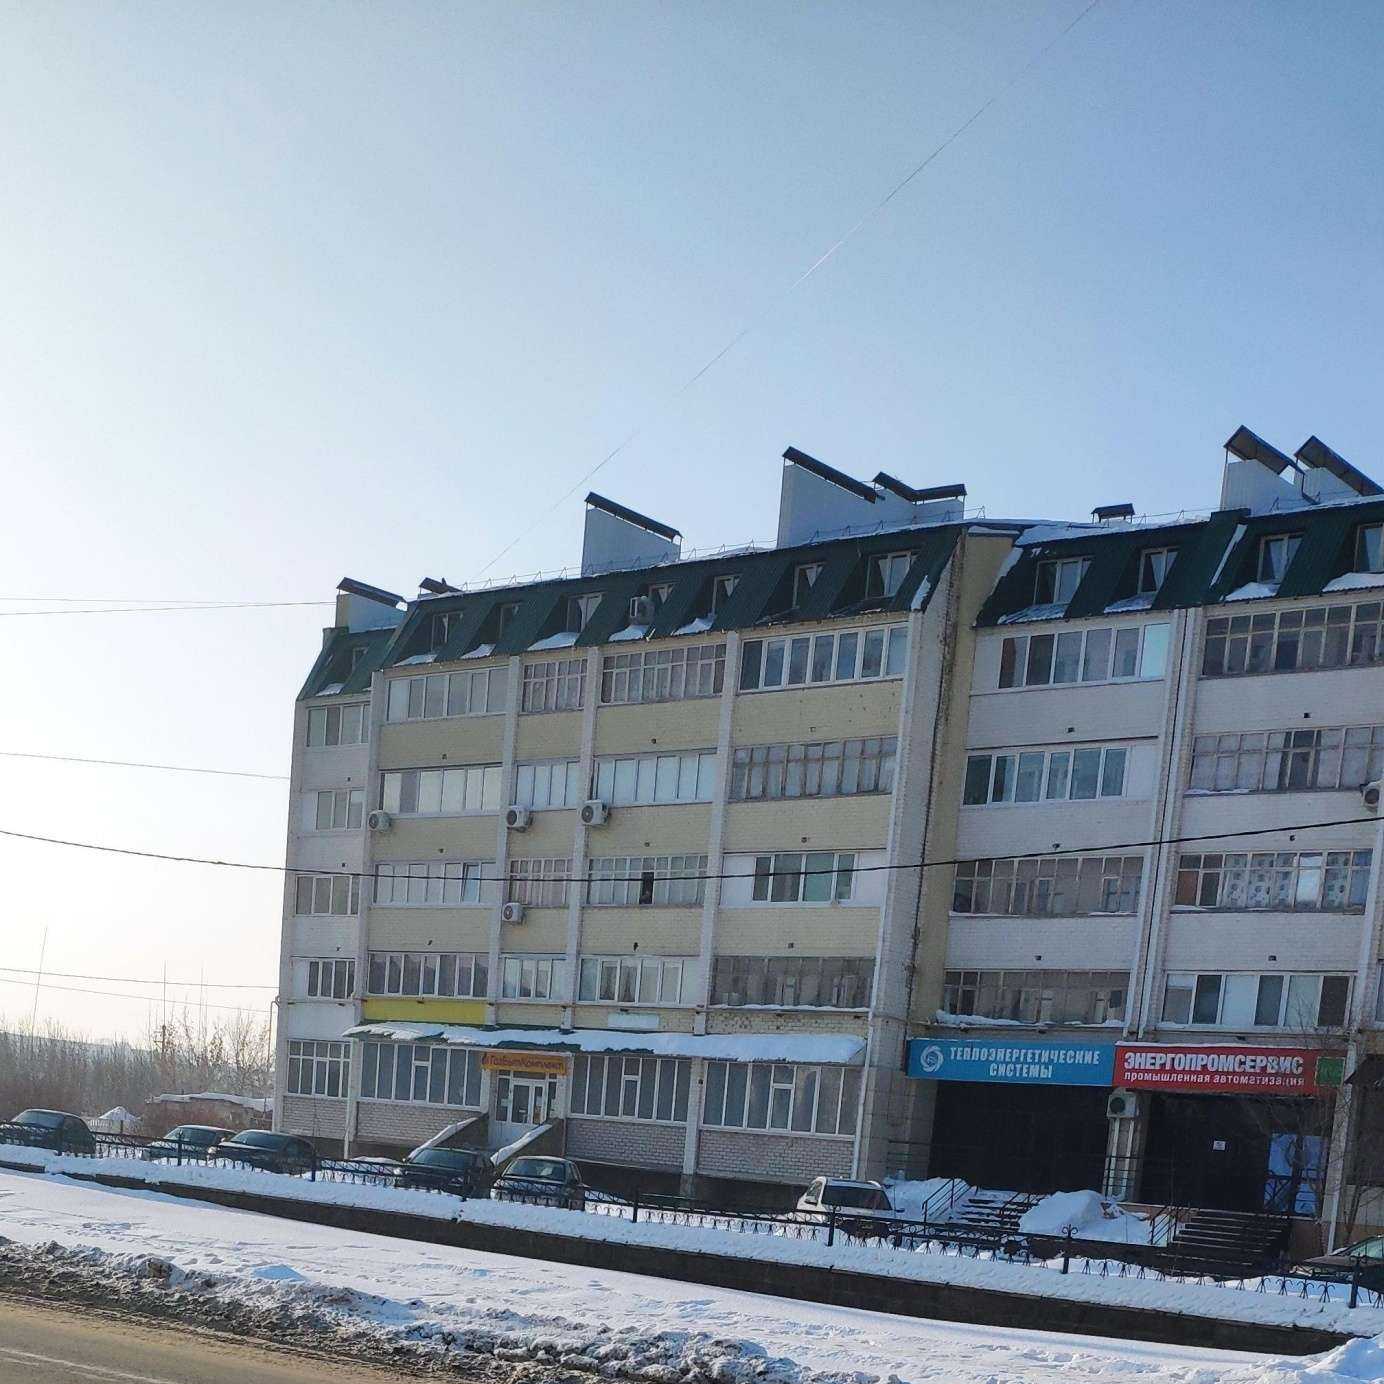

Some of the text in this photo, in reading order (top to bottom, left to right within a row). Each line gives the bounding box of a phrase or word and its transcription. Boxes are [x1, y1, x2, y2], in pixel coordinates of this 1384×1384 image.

[949, 1047, 1100, 1065] ТЕПЛОЭНЕРГЕТИЧЕСКИЕ
[1123, 1052, 1304, 1075] ЭНЕРГОПРОМСЕРВИС
[989, 1063, 1053, 1078] СИСТЕМЫ
[1123, 1072, 1210, 1084] промышленная
